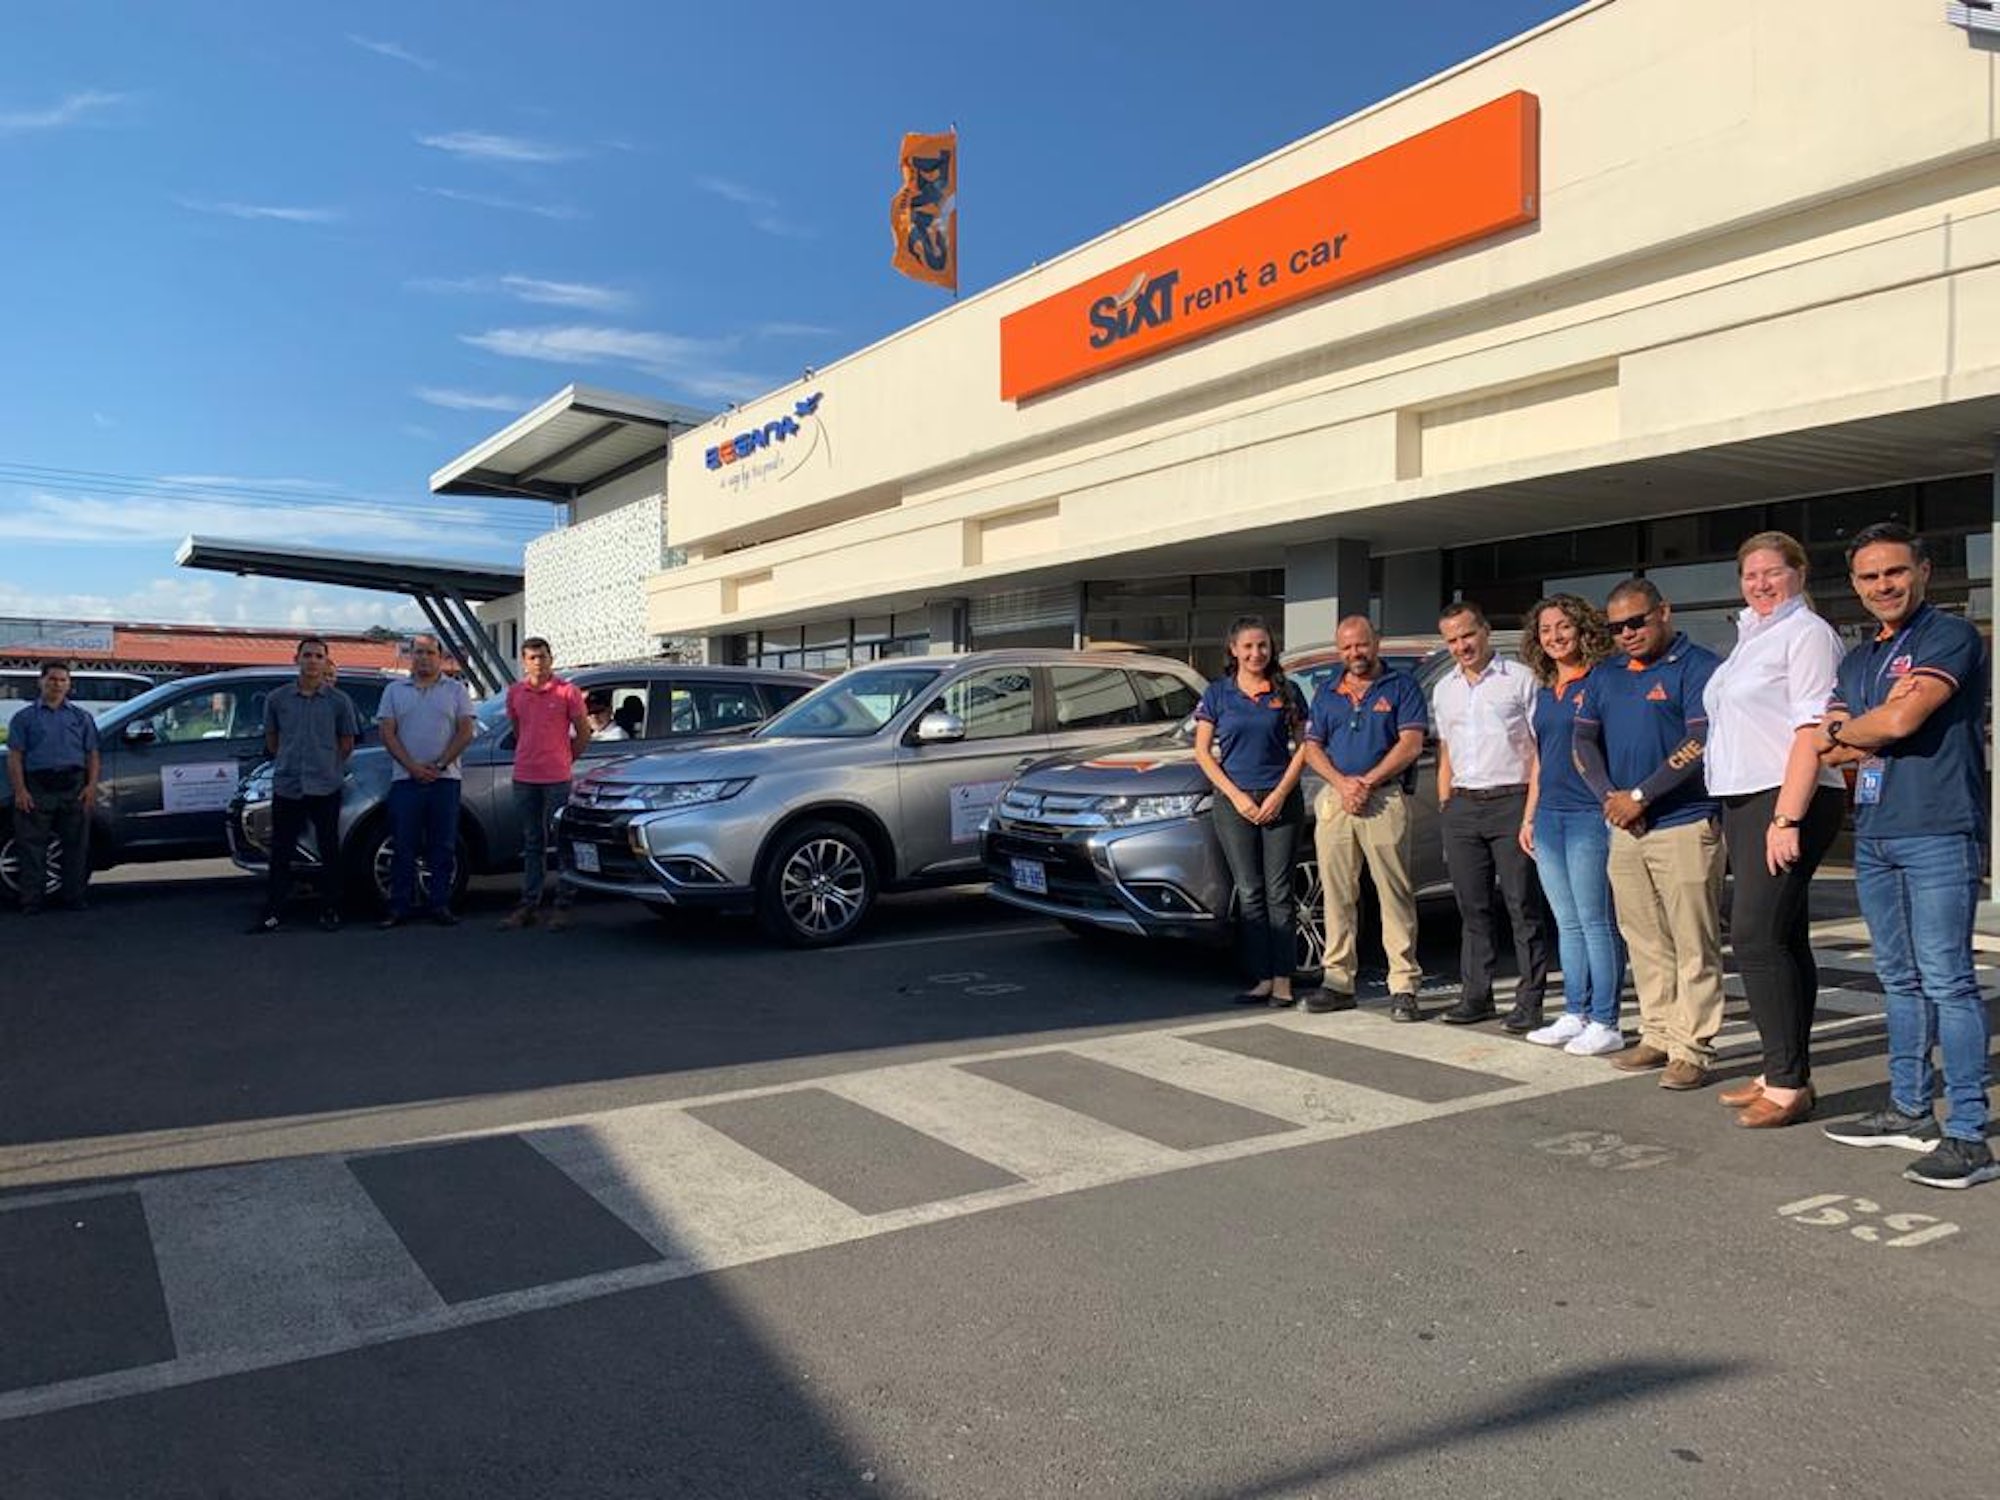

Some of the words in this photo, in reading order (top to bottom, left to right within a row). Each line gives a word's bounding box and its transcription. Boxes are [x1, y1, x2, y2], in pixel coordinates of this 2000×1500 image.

[1183, 267, 1248, 316] rent
[1258, 261, 1278, 288] a
[1289, 234, 1348, 275] car
